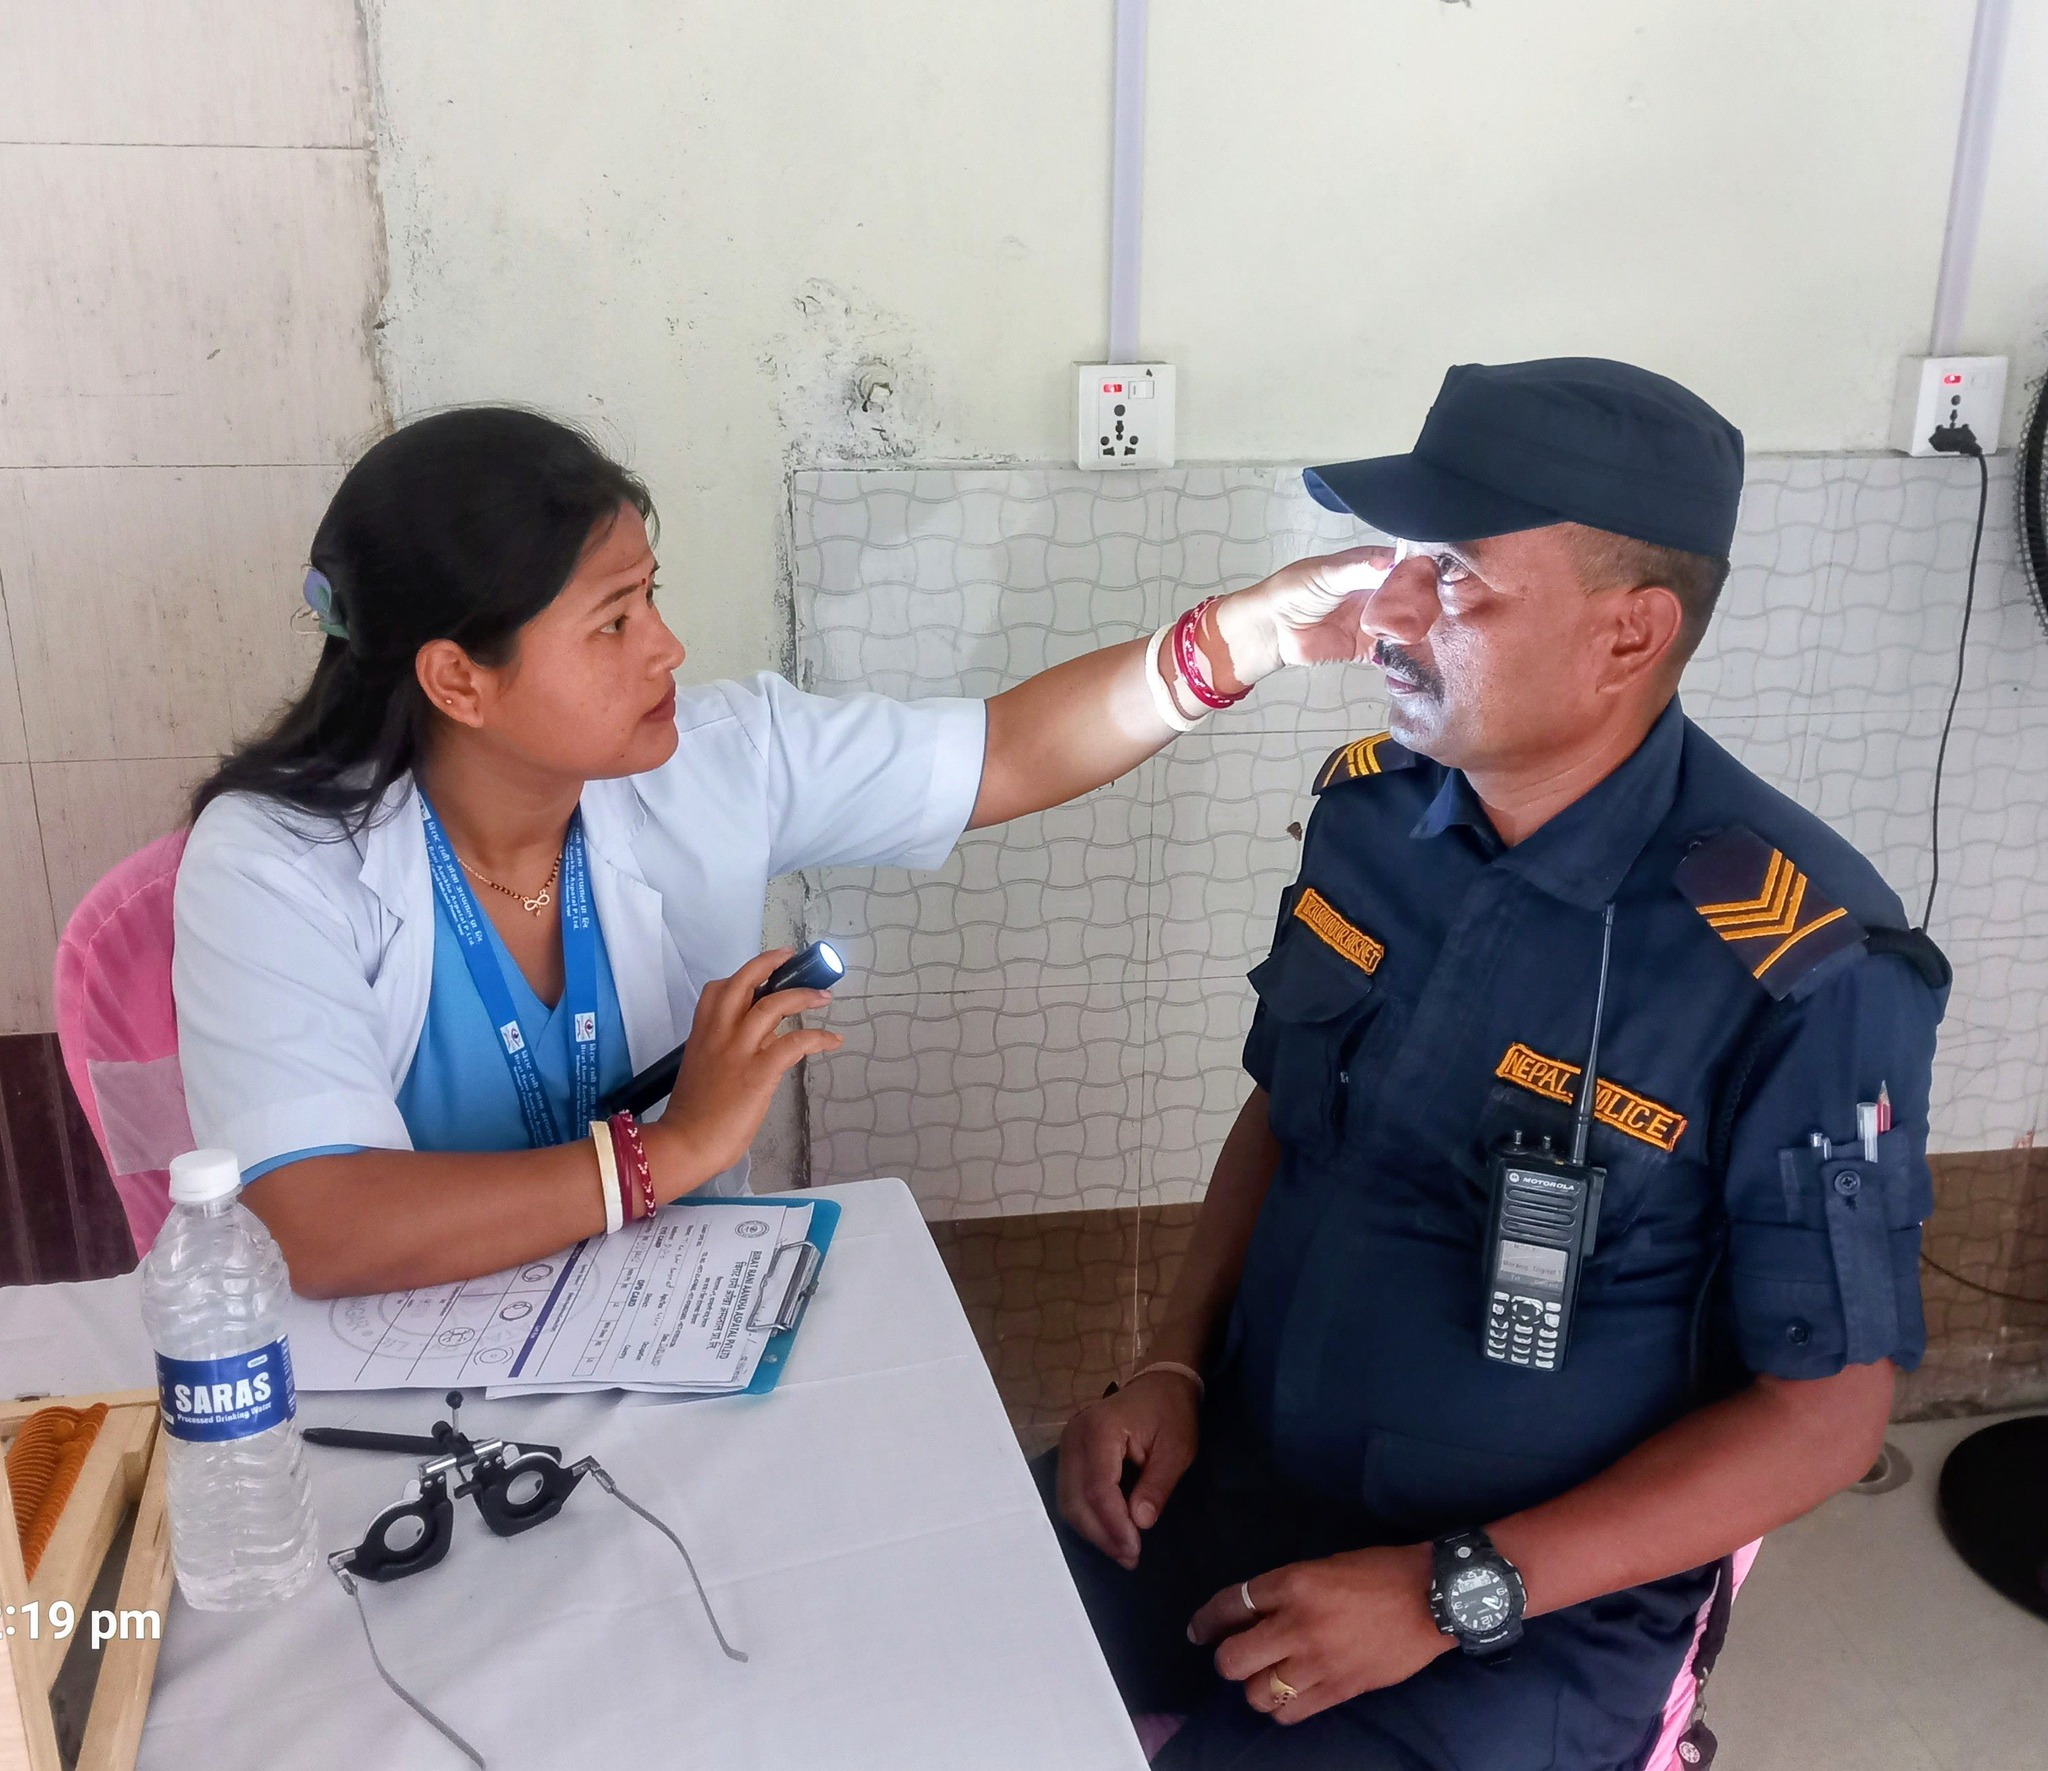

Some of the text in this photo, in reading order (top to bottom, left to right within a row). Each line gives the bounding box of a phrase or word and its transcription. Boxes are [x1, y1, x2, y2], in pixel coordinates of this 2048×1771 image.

[451, 896, 466, 924] Aspatal
[1595, 1087, 1673, 1139] OLICE
[1522, 1176, 1575, 1190] MOTOROLA
[748, 1251, 762, 1268] BIRAT
[743, 1269, 756, 1284] RANI
[734, 1284, 751, 1310] AANKHA
[727, 1311, 743, 1338] ASPATAL
[174, 1371, 271, 1414] SARAS
[177, 1413, 213, 1424] Processed
[216, 1410, 250, 1423] Drinking
[251, 1402, 272, 1416] Water
